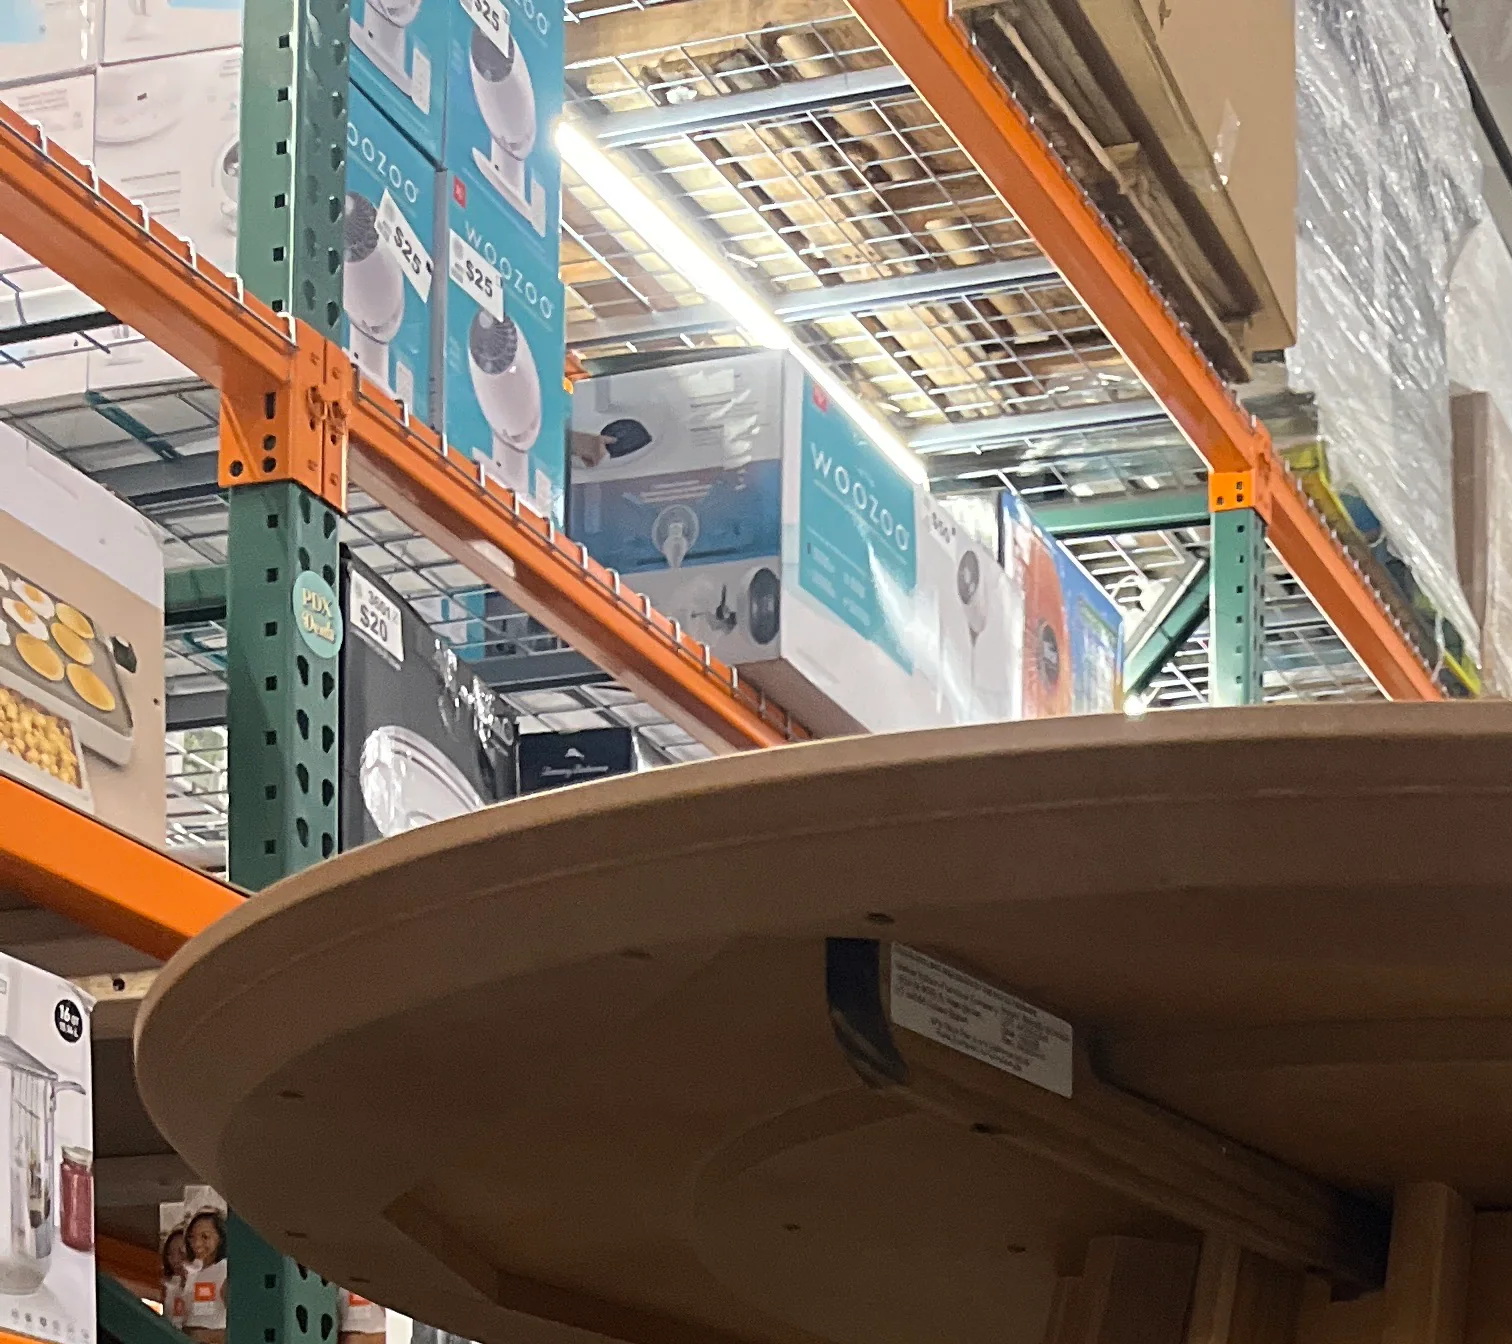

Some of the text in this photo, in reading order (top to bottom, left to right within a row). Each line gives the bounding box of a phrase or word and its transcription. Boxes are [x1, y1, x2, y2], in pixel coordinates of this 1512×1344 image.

[346, 122, 417, 203] OOZOO
[393, 226, 422, 276] $25
[465, 221, 552, 319] WOOZOO
[465, 260, 494, 298] $25
[810, 440, 909, 551] WOOZOO
[302, 587, 333, 619] PDX
[360, 604, 388, 642] $20
[59, 1004, 71, 1023] 16
